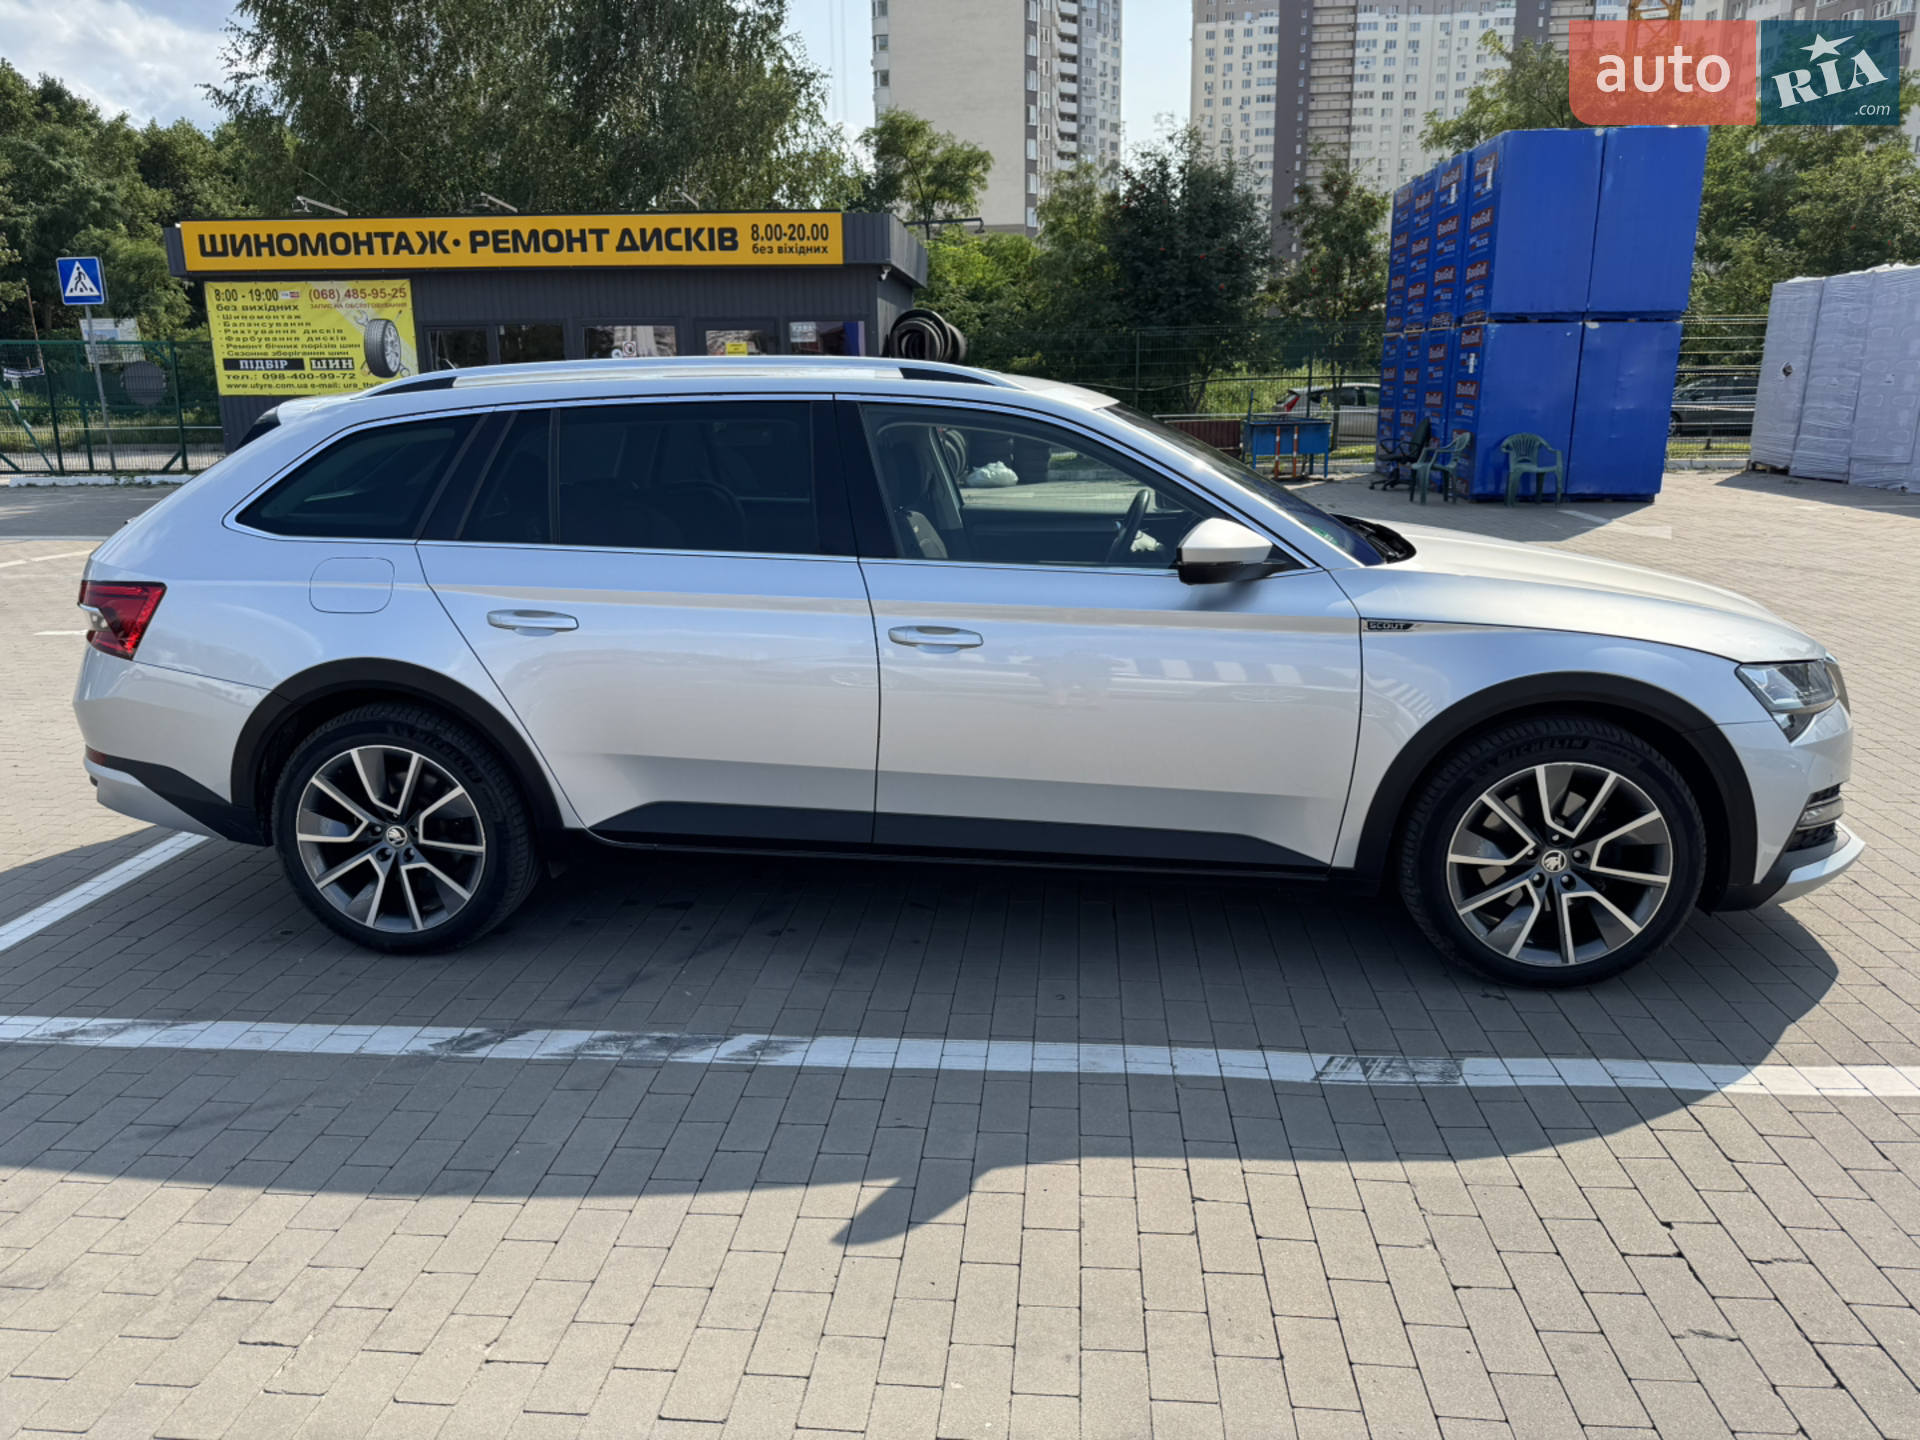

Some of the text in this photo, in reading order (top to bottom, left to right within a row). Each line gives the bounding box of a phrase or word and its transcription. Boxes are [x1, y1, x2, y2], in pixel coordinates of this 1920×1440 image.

[750, 223, 829, 242] 8.00-20.00
[198, 226, 740, 258] ШИНОМОНТАЖ РЕМОНТ ДИСКІВ
[752, 242, 828, 256] без віхідних
[214, 288, 238, 302] 8:00
[248, 288, 279, 302] 19:00
[309, 288, 341, 303] (068)
[344, 287, 407, 300] 485-95-25
[216, 303, 300, 312] без вихідних
[239, 359, 354, 370] ПІДБІР ШИН
[262, 372, 356, 381] 098-400-99-72
[1497, 738, 1583, 766] MICHELIN
